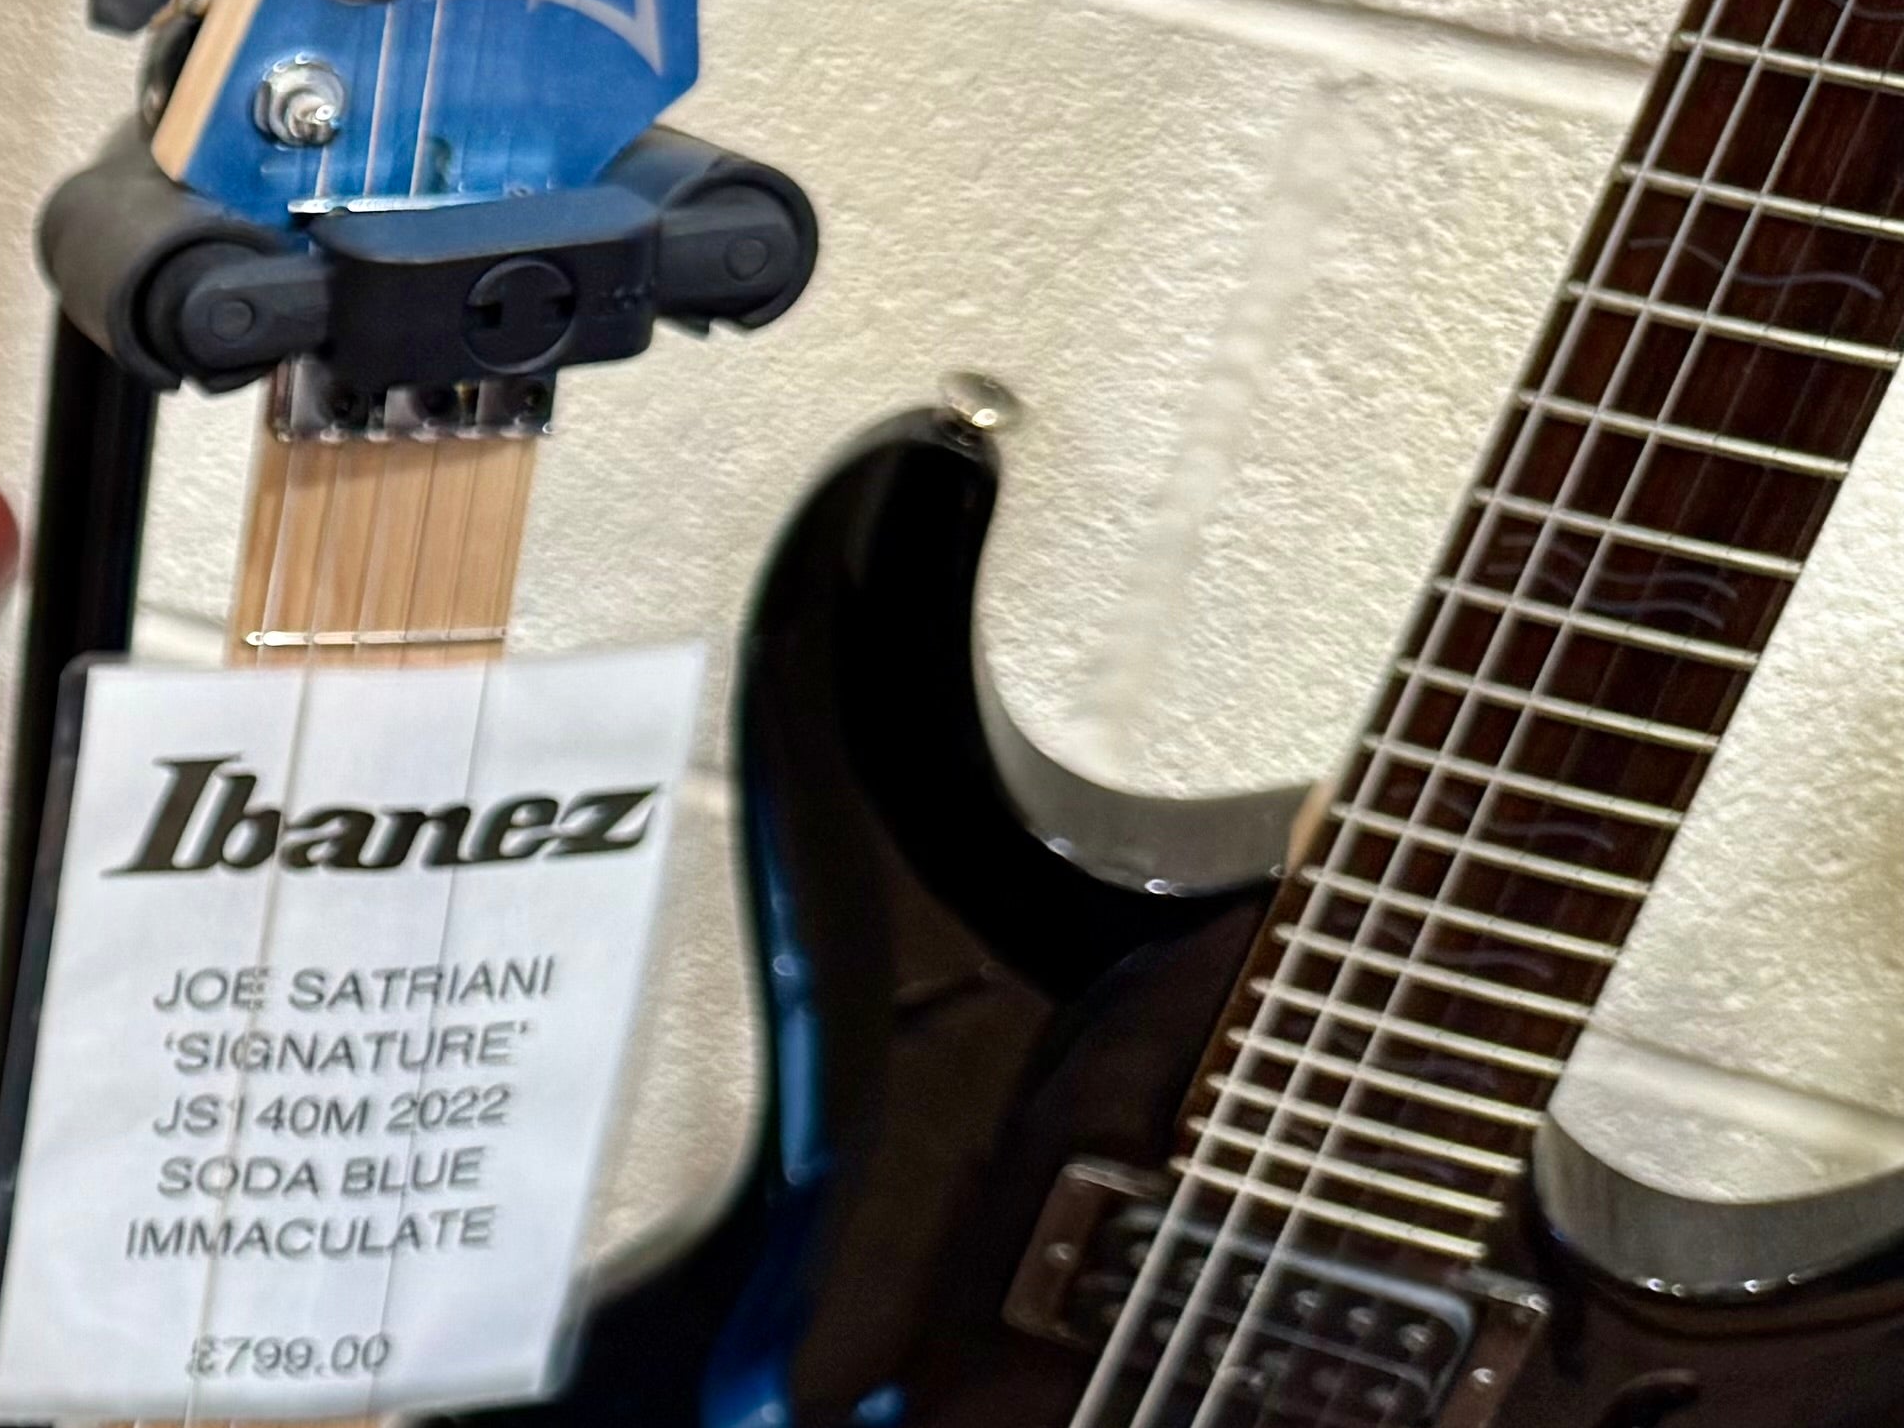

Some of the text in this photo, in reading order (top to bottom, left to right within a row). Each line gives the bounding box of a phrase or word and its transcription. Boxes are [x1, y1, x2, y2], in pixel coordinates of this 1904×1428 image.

[100, 751, 662, 879] Ibanez
[153, 954, 557, 1012] JOE SATRIANI
[386, 1082, 514, 1134] 2022
[157, 1144, 487, 1200] SODA BLUE
[125, 1204, 500, 1261] IMMACULATE
[186, 1332, 393, 1377] £799.00
